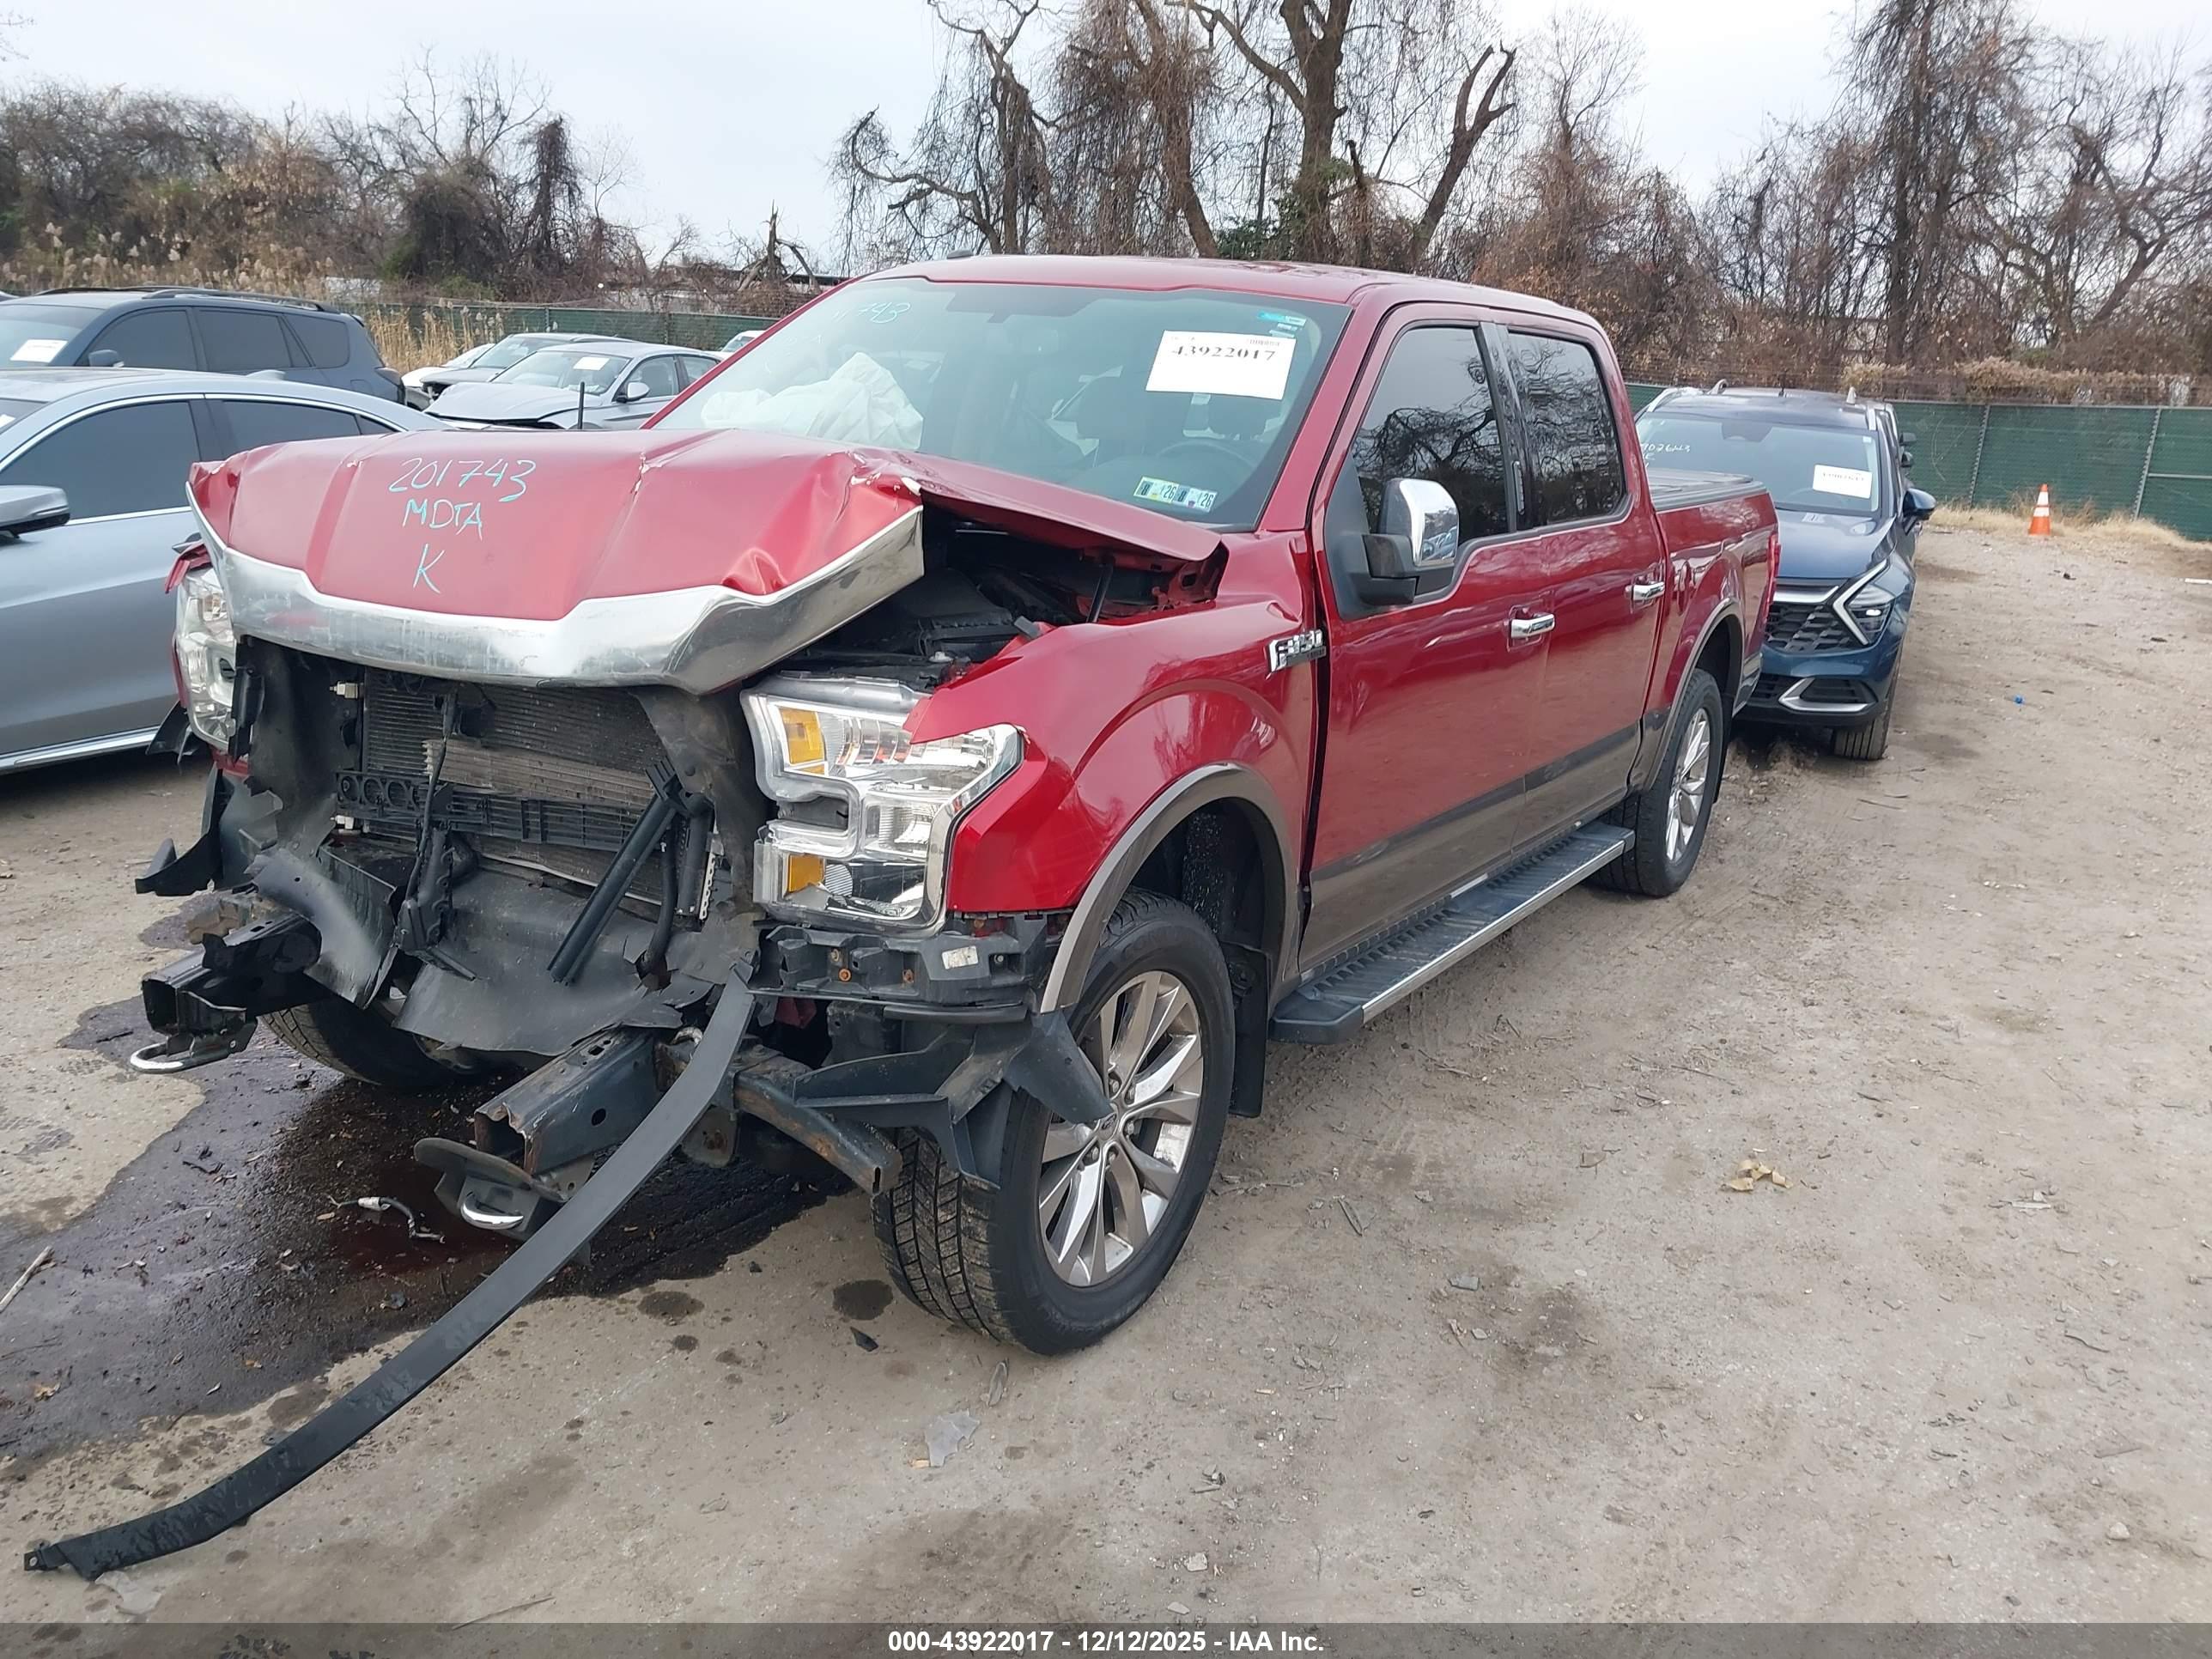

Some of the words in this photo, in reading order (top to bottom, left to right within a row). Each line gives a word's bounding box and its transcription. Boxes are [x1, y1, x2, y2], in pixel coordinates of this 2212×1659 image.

[1171, 345, 1276, 362] 43922017
[388, 457, 537, 502] 201743
[402, 499, 483, 541] MDTA
[412, 543, 446, 594] K
